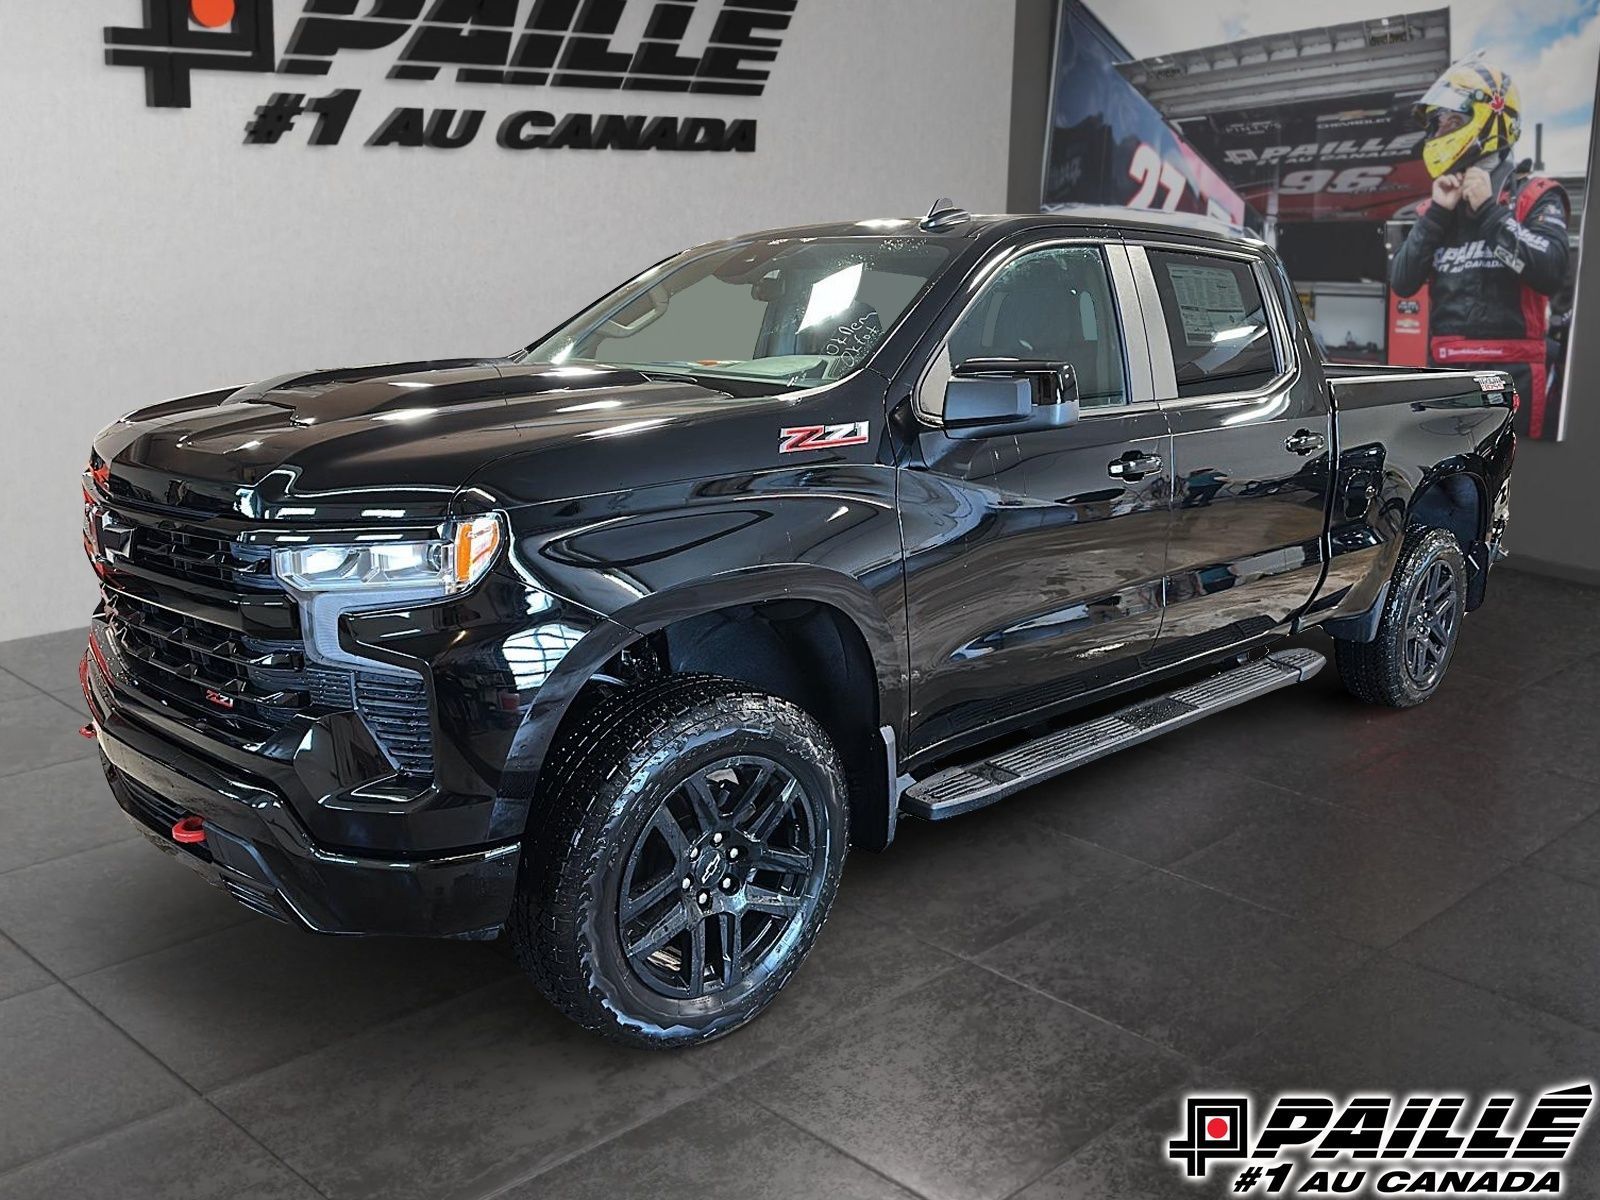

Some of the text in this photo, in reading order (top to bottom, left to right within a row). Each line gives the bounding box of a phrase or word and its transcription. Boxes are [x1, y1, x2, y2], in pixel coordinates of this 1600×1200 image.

[242, 89, 757, 152] #1 AU CANADA
[1316, 117, 1392, 130] CHEVROLET
[1285, 155, 1315, 165] AU
[1320, 149, 1412, 162] CANADA
[1126, 143, 1187, 214] 27
[1280, 166, 1394, 195] 96
[779, 421, 869, 453] Z71
